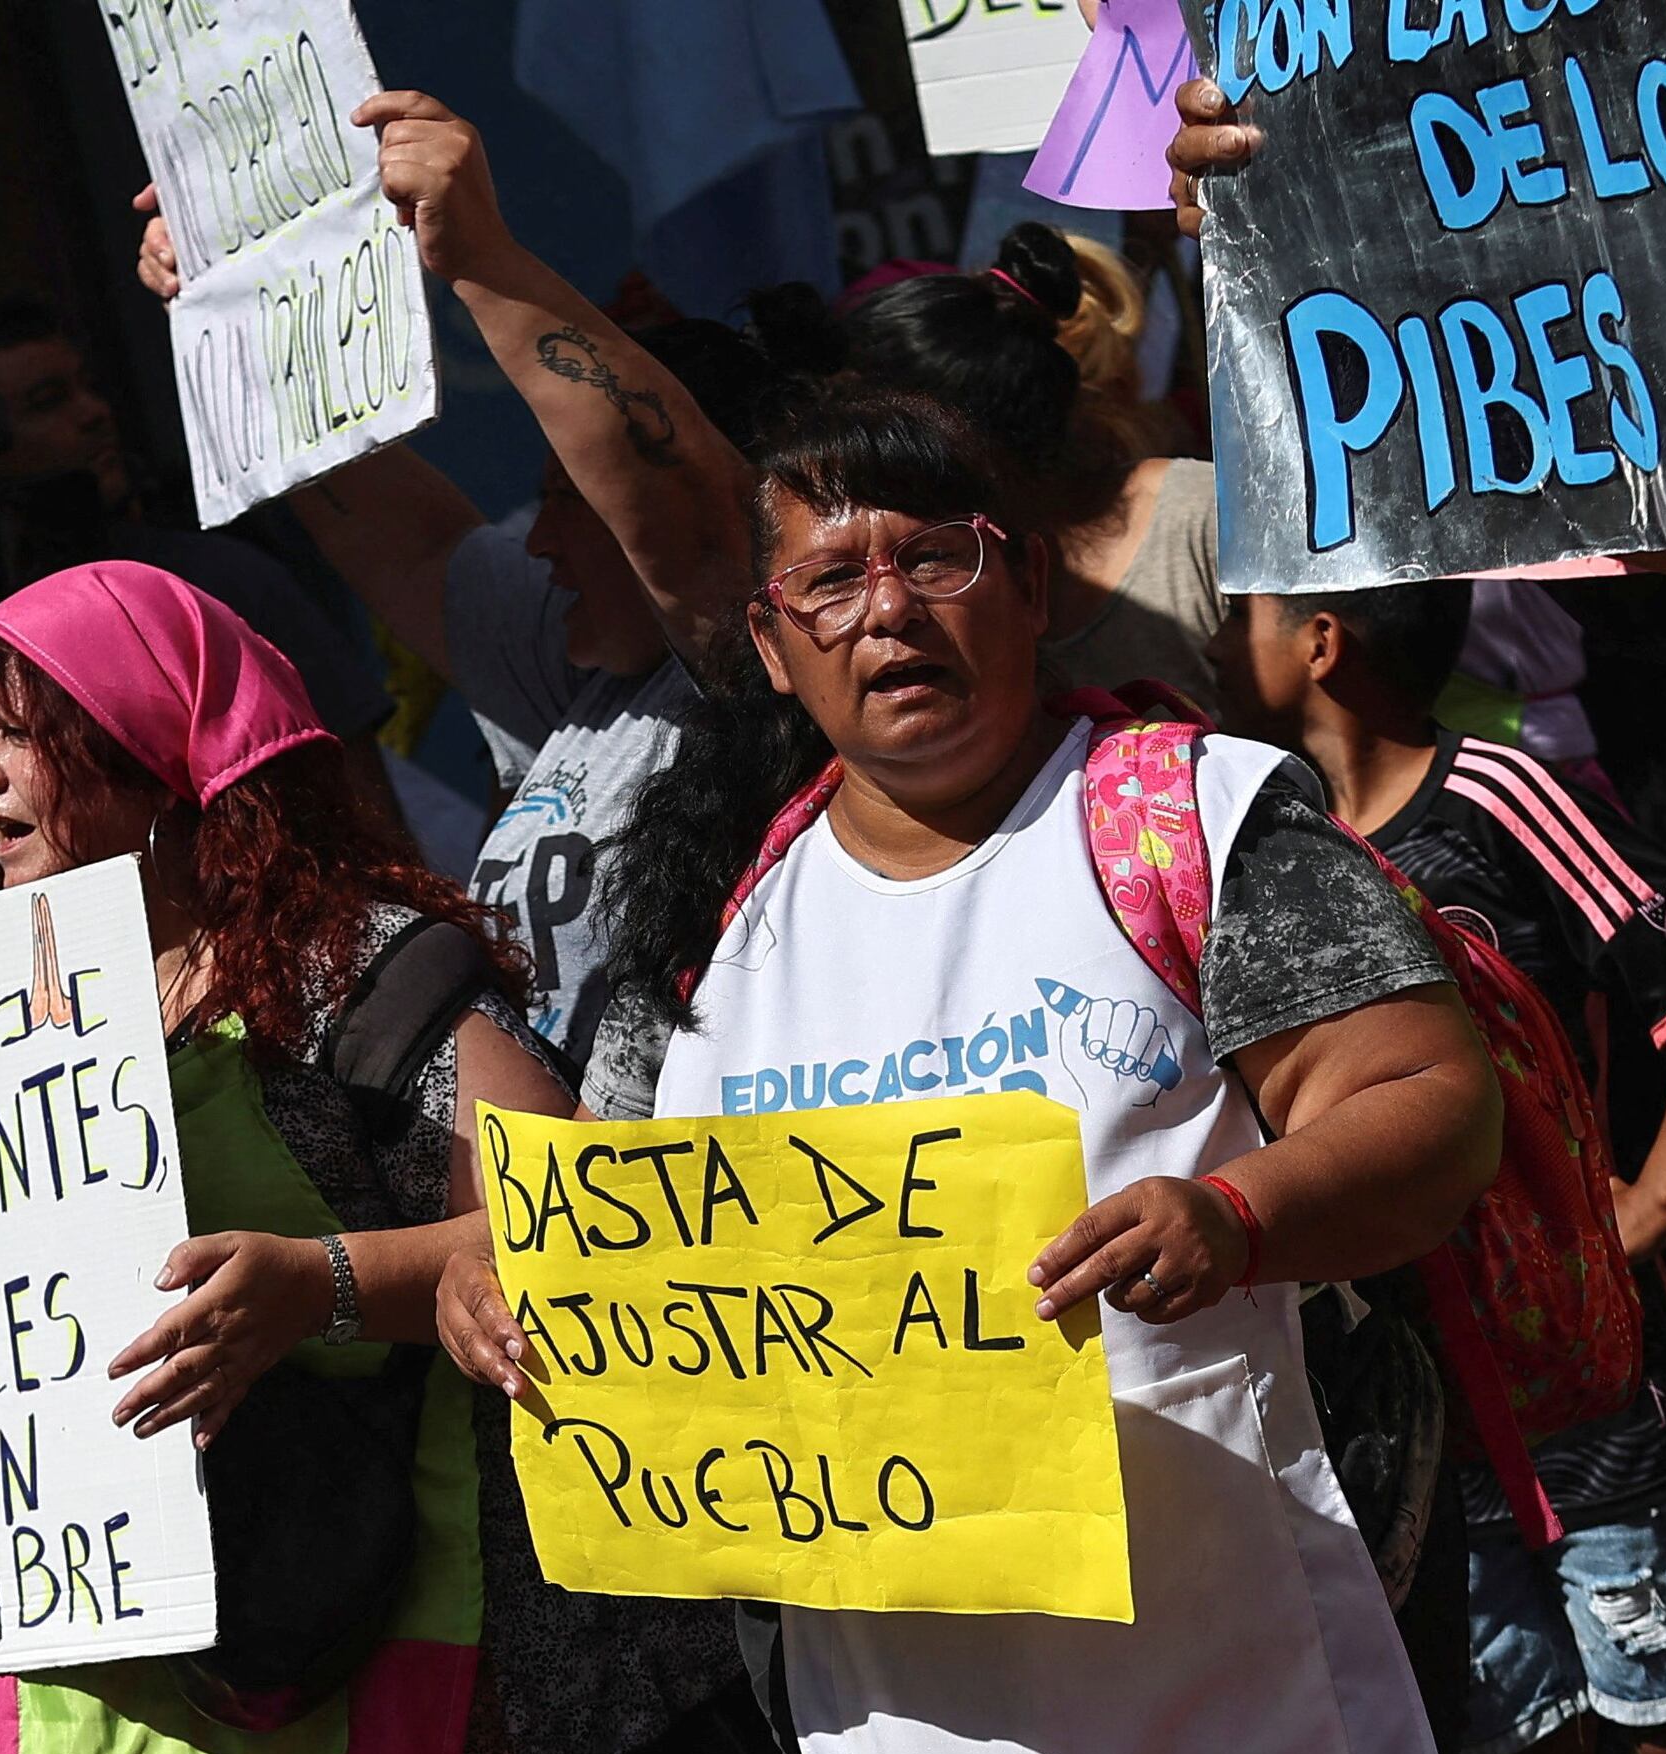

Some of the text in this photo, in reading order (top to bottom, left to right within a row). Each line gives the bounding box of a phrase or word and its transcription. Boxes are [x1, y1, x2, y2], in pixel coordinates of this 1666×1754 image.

[1408, 77, 1569, 232] DE
[1282, 270, 1660, 553] PIBES
[720, 1006, 1049, 1117] EDUCACIÓN
[483, 1113, 962, 1257] BASTA DE
[516, 1268, 1026, 1381] AJUSTAR AL
[542, 1417, 935, 1543] PUEBLO
